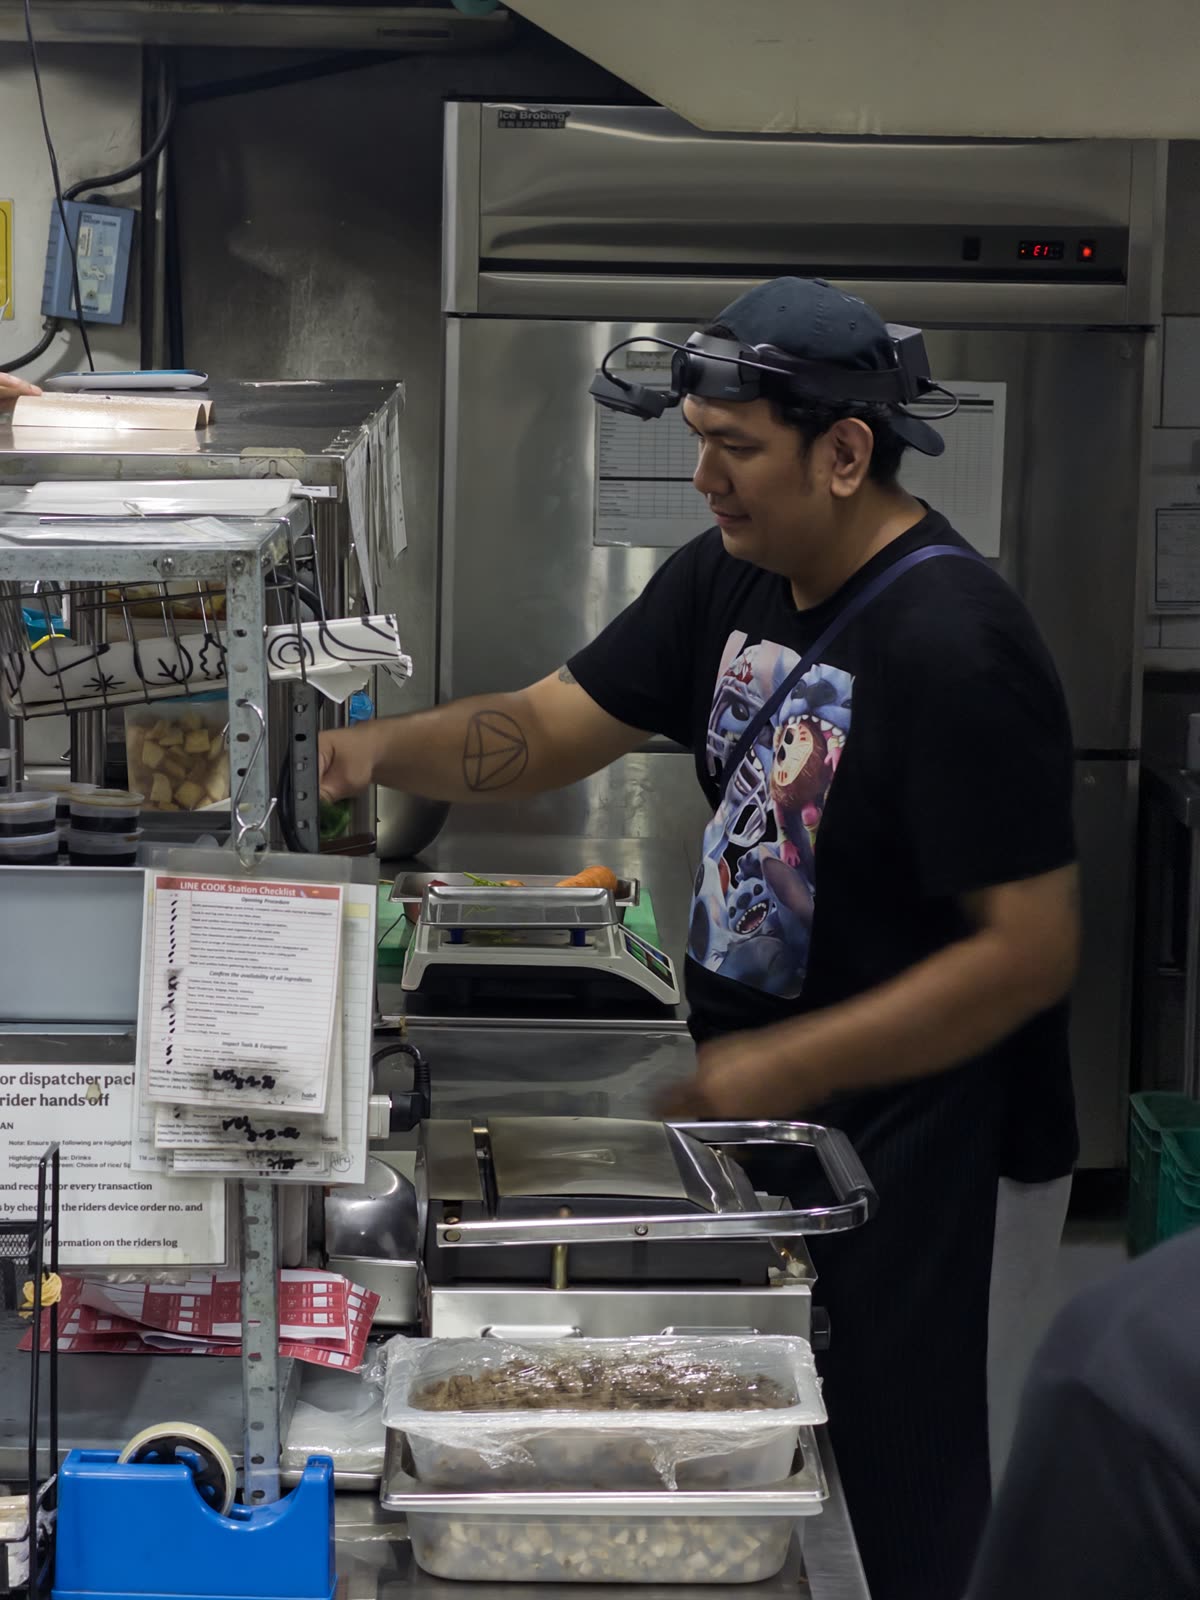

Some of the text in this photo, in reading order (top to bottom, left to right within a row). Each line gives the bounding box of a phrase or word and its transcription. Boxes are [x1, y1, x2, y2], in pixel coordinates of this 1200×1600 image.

[180, 882, 296, 897] LINE COOK Station Checklist
[19, 1072, 101, 1089] dispatcher
[0, 1093, 110, 1107] rider hands off
[62, 1139, 92, 1148] following
[75, 1162, 99, 1170] Choice
[99, 1162, 107, 1170] of
[0, 1182, 17, 1191] and
[69, 1183, 97, 1193] every
[98, 1182, 153, 1191] transaction
[3, 1203, 15, 1214] by
[61, 1203, 77, 1212] the
[78, 1203, 107, 1212] riders
[107, 1203, 139, 1212] device
[140, 1203, 167, 1212] order
[168, 1204, 184, 1212] no.
[184, 1203, 204, 1212] and
[44, 1238, 179, 1249] inormation on the riders log
